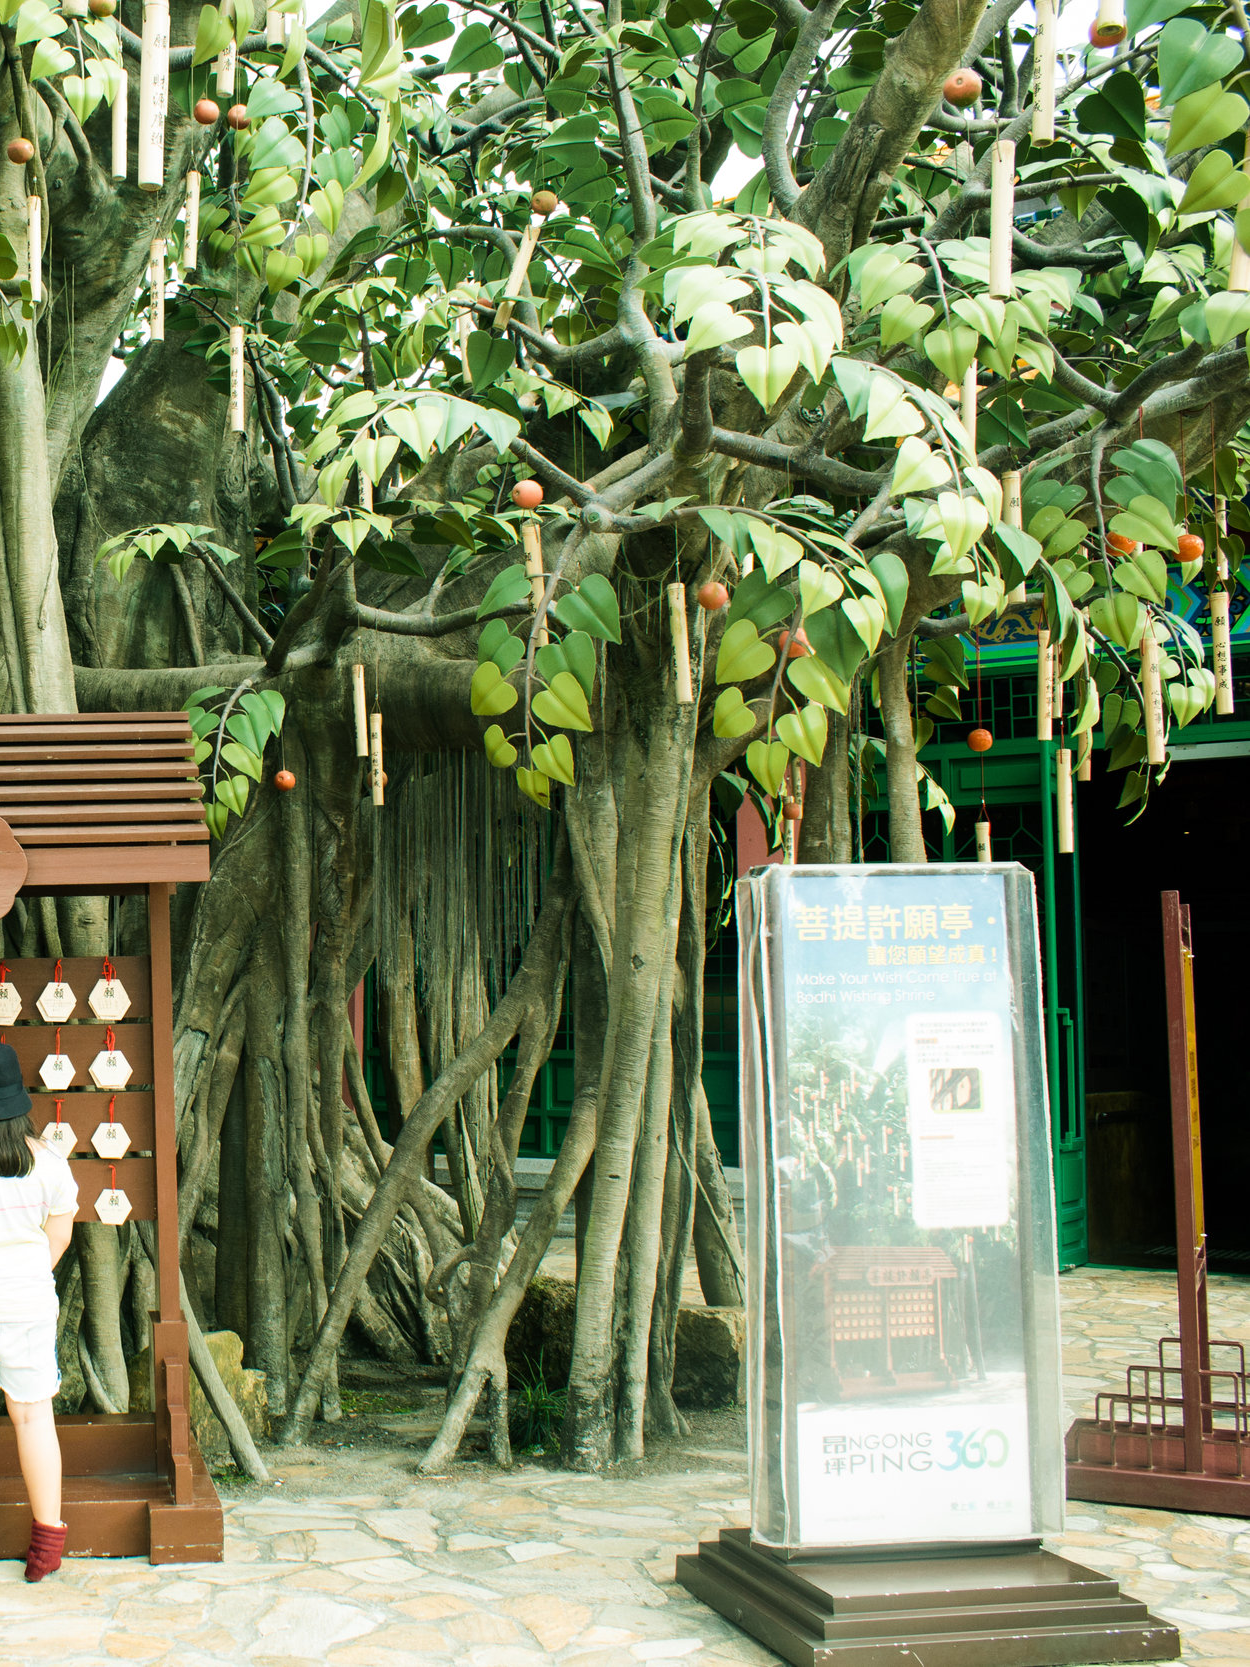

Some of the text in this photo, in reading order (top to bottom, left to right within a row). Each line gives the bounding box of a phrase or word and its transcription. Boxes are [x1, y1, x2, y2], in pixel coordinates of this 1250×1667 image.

[796, 970, 998, 986] Make Your Wish Come True at
[796, 989, 936, 1006] Bodhi Wishing Shrine
[849, 1432, 933, 1449] NGONG
[936, 1427, 1010, 1472] 360
[849, 1450, 933, 1474] PING
